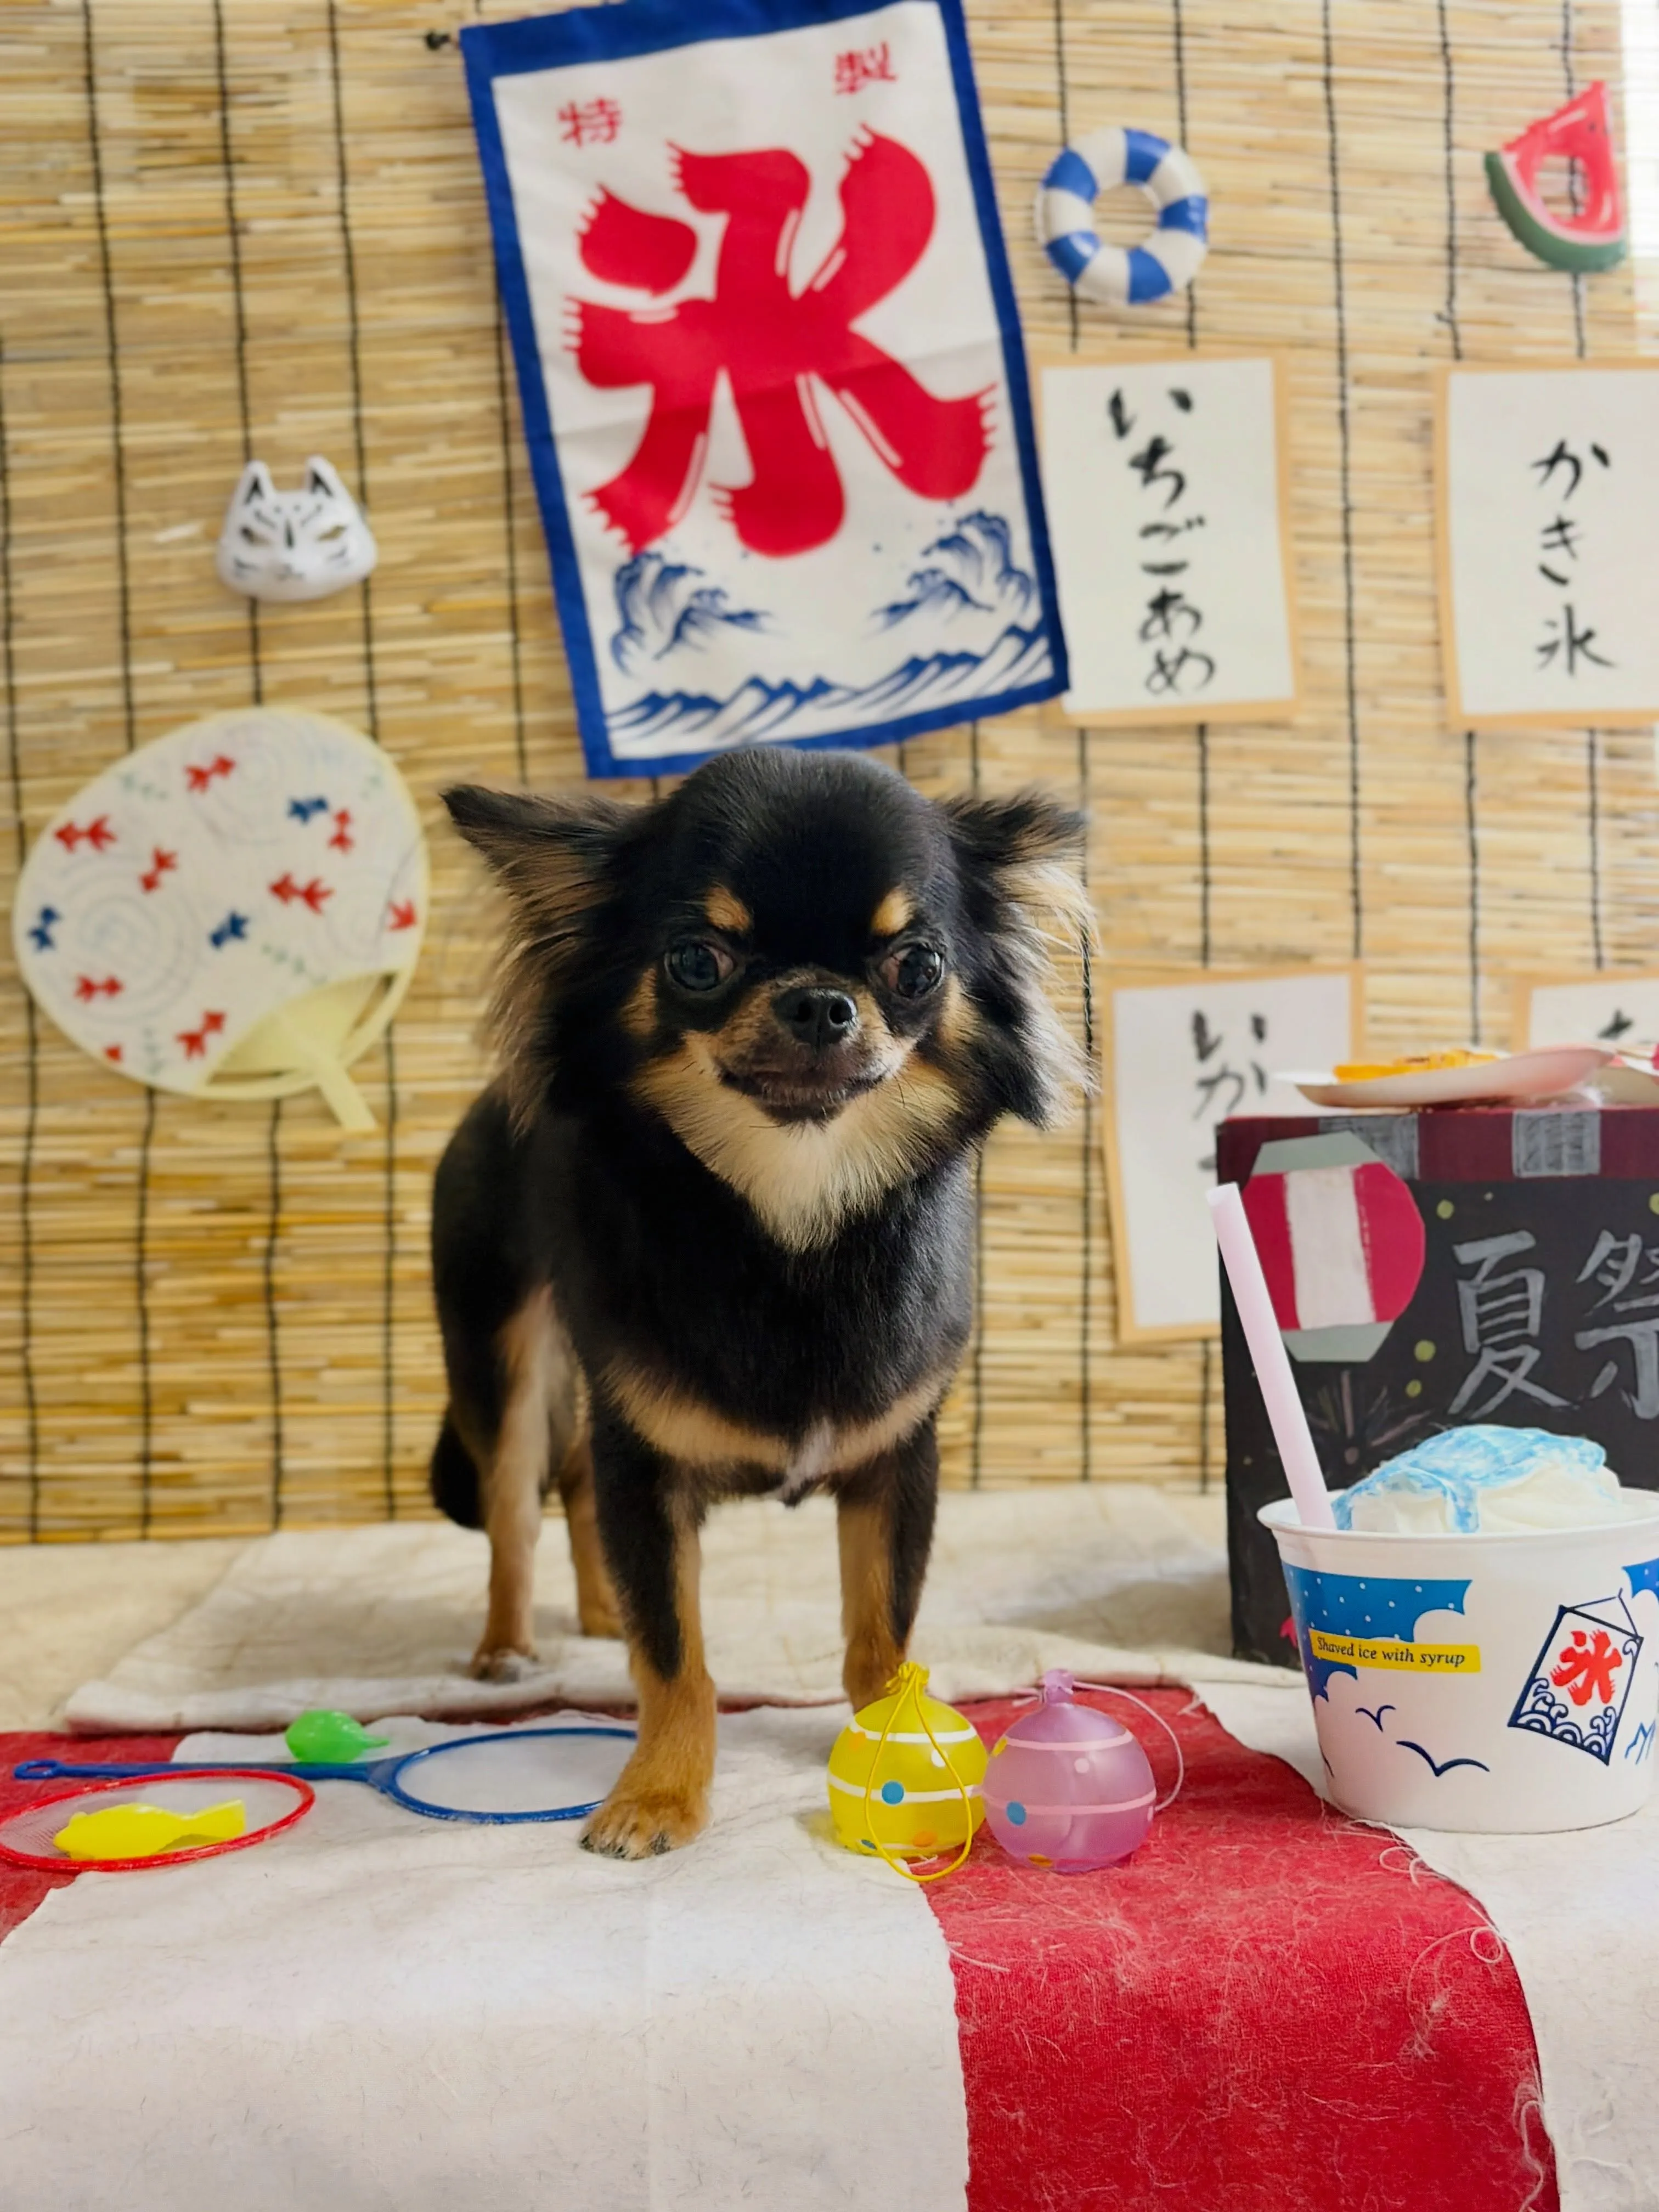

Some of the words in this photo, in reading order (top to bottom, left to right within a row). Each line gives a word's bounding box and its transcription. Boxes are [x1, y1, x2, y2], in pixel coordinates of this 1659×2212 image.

[558, 96, 622, 149] 特
[562, 122, 1000, 561] 氷
[1107, 387, 1216, 696] いちごあめ
[1529, 439, 1617, 678] かき氷
[1192, 1009, 1267, 1171] いか
[1317, 1636, 1354, 1657] Shaved
[1358, 1645, 1376, 1660] ice
[1382, 1648, 1414, 1663] with
[1420, 1652, 1465, 1668] syrup
[1549, 1629, 1623, 1707] 氷
